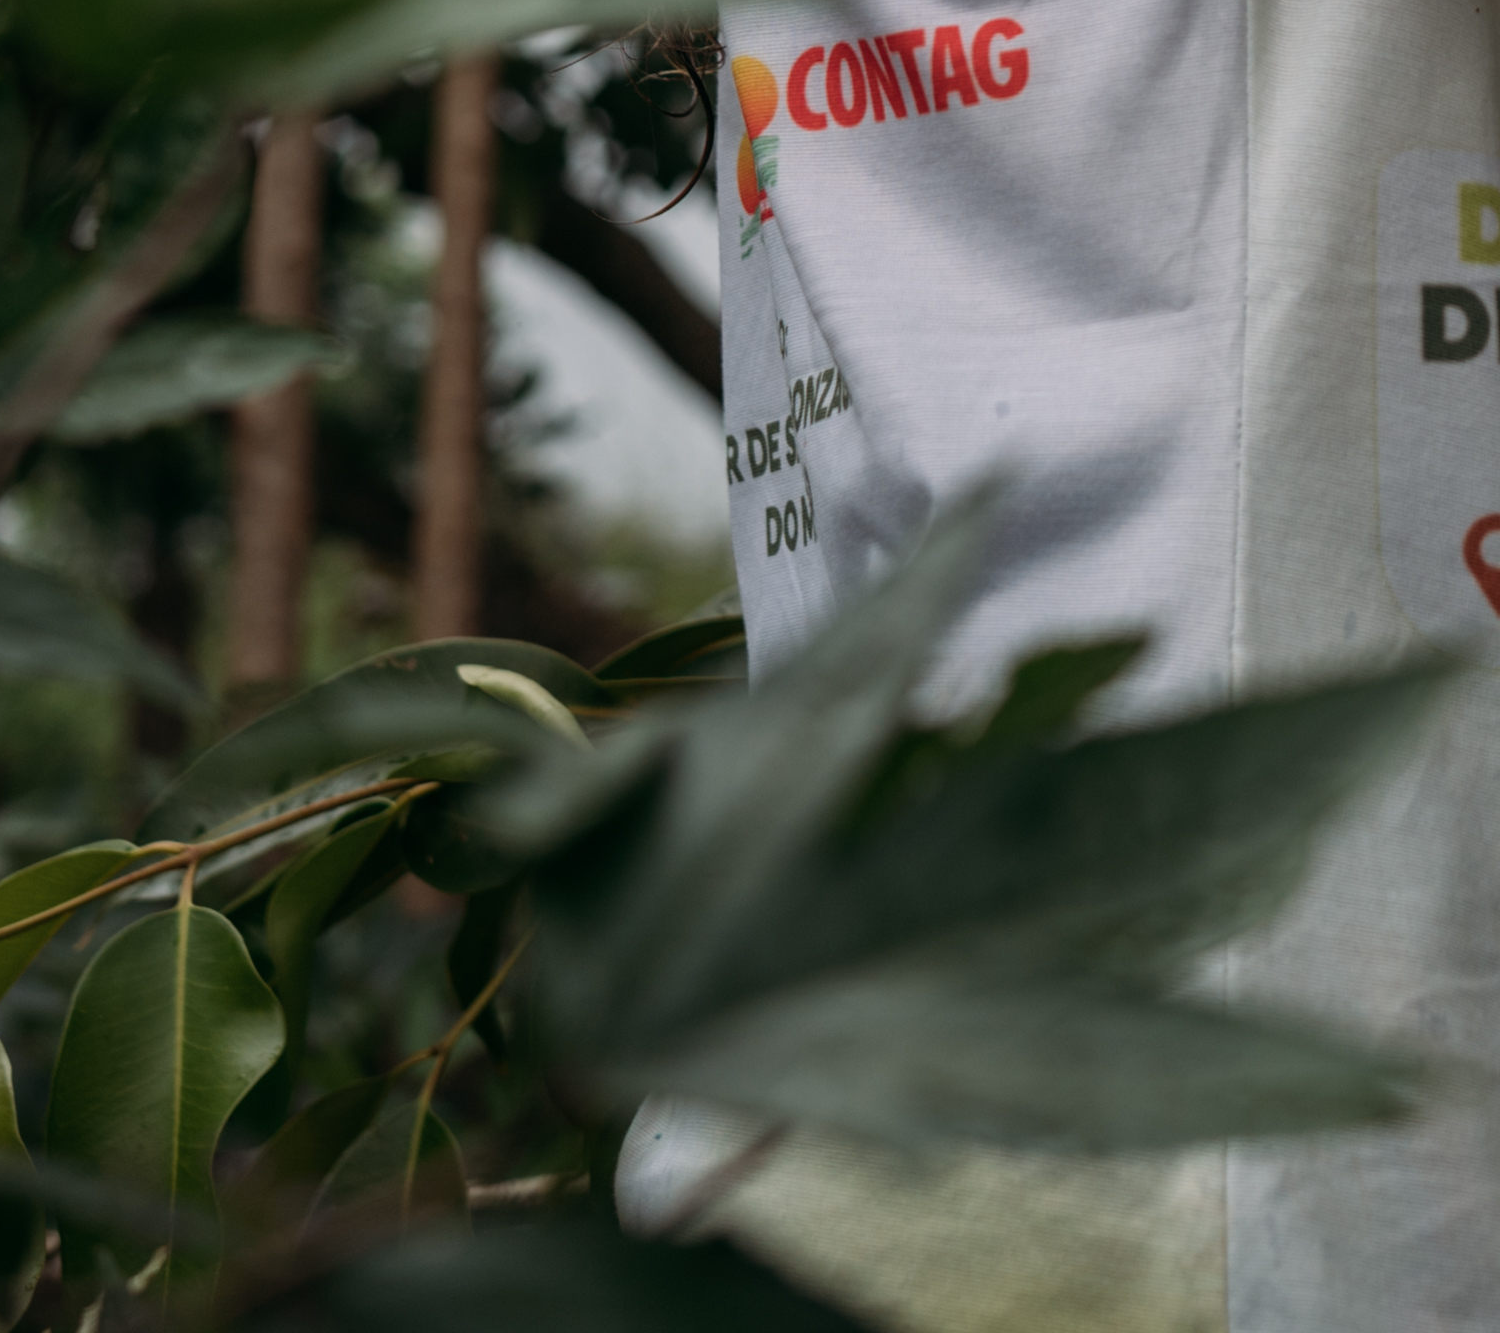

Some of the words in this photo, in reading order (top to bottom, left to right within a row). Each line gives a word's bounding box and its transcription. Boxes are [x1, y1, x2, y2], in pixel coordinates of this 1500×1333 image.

[786, 17, 1030, 131] CONTAG
[745, 420, 782, 479] DE
[765, 498, 799, 557] DO
